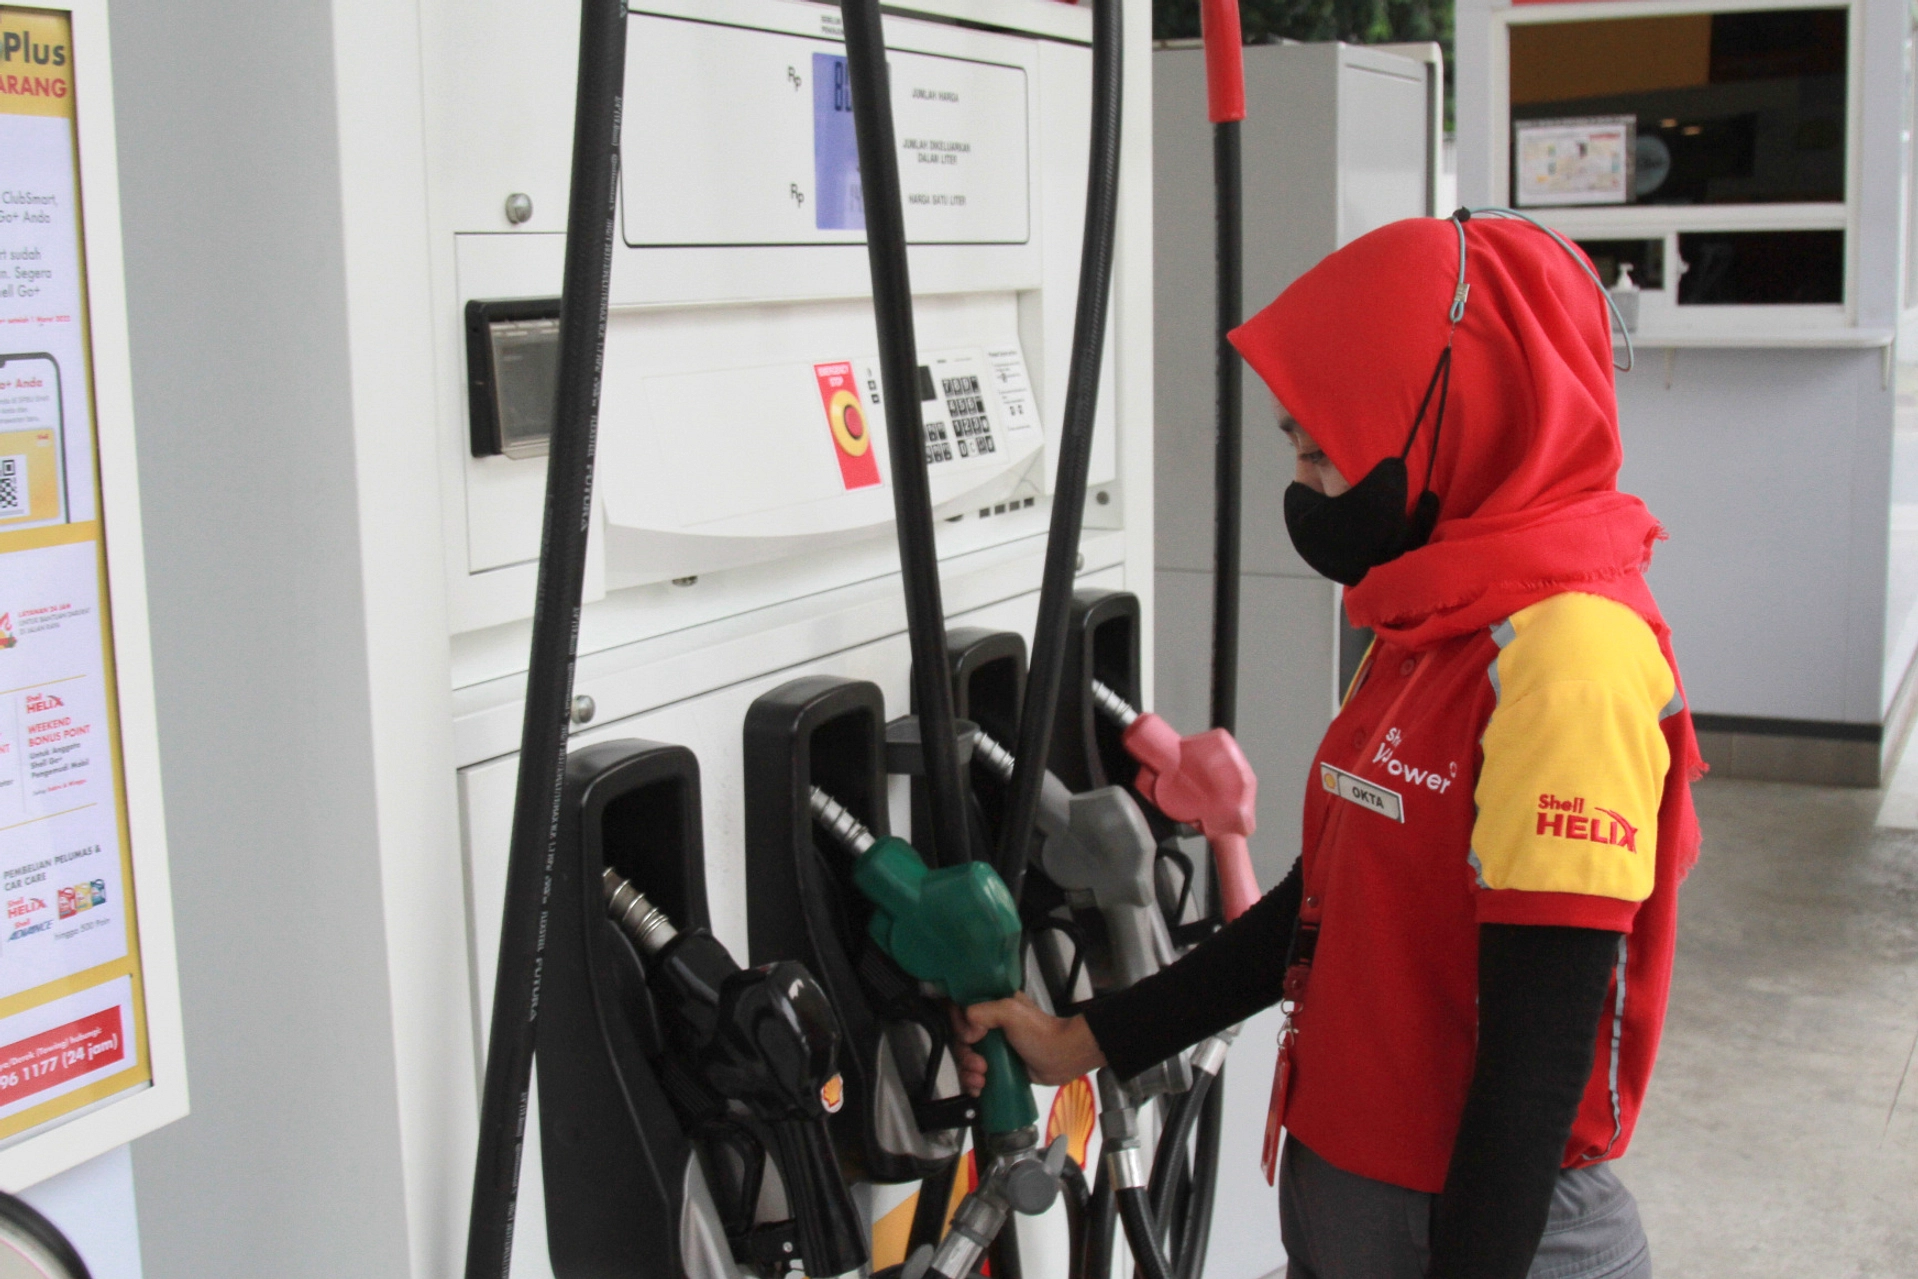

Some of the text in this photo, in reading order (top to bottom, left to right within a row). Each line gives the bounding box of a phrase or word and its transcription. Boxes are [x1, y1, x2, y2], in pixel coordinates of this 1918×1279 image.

[0, 31, 66, 66] Plus
[788, 65, 802, 92] Rp
[790, 183, 805, 209] Rp
[23, 210, 51, 223] Anda
[10, 247, 41, 260] sudah
[15, 266, 52, 282] Segera
[17, 284, 41, 297] Go+
[26, 695, 64, 714] HELIX
[28, 717, 71, 734] WEEKEND
[29, 724, 91, 747] BONUS POINT
[1351, 786, 1385, 809] OKTA
[1537, 794, 1585, 814] Shell
[1536, 807, 1638, 854] HELIX
[3, 860, 52, 880] PEMBELIAN
[54, 846, 93, 865] PELUMAS
[4, 872, 47, 891] CAR CARE
[7, 898, 47, 918] HELIX
[22, 1056, 58, 1081] 1177
[62, 1046, 85, 1068] (24
[87, 1033, 118, 1060] jam)
